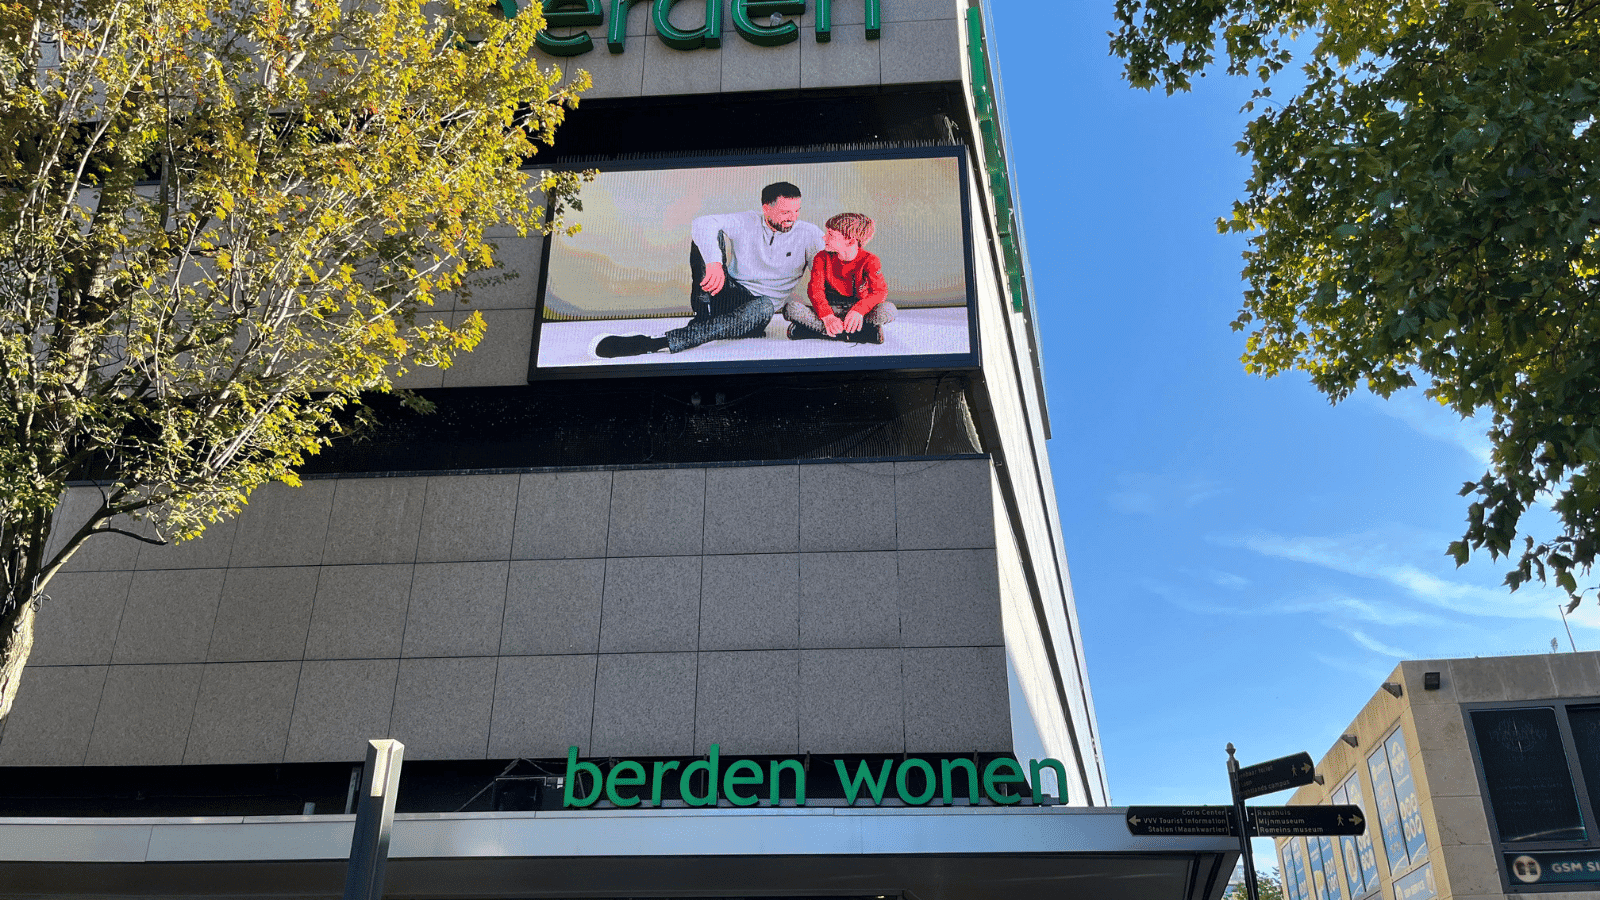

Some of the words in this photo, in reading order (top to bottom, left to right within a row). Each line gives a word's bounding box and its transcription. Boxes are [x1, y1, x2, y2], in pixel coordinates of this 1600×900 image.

[563, 744, 807, 808] berden
[833, 757, 1069, 806] wonen
[1268, 779, 1290, 789] campus
[1258, 818, 1305, 826] Mijnmuseum
[1551, 862, 1583, 873] GSM
